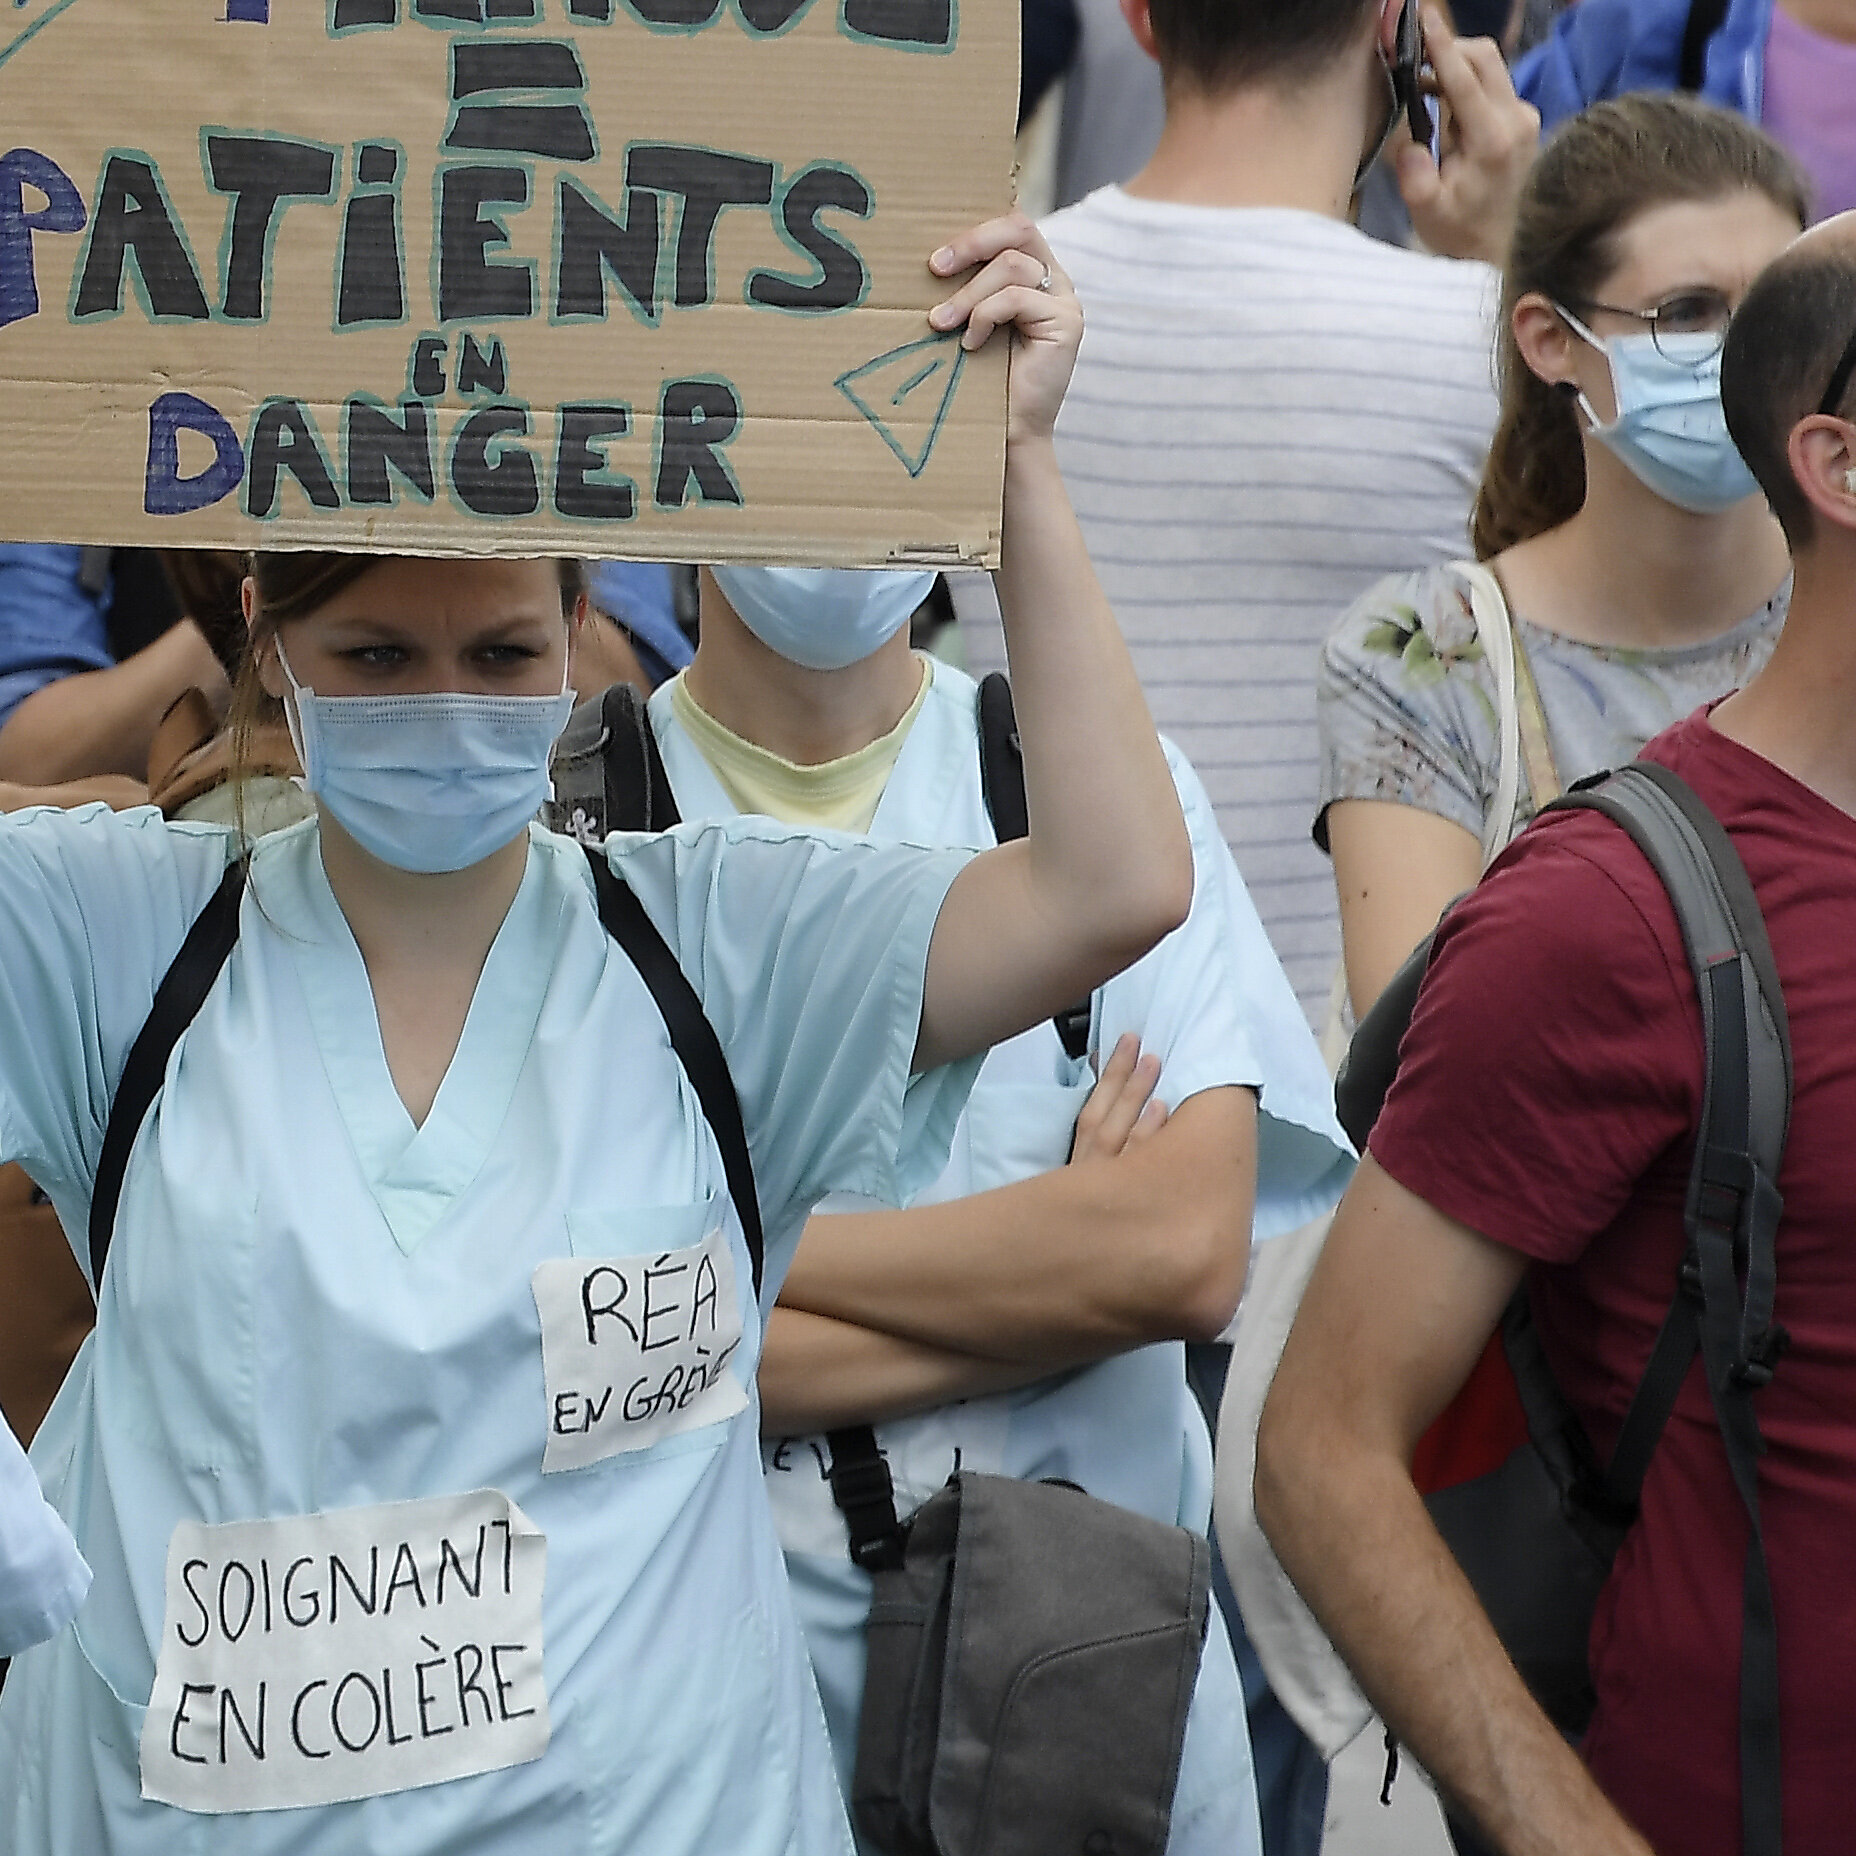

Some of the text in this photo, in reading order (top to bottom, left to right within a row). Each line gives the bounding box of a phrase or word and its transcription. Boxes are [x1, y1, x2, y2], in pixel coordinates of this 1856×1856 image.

[406, 330, 510, 400] EN
[144, 375, 745, 521] DANGER
[581, 1253, 720, 1355] RÉA
[552, 1386, 613, 1435] EN
[176, 1518, 512, 1647] SOIGNANT
[169, 1634, 536, 1765] EN COLÈRE
